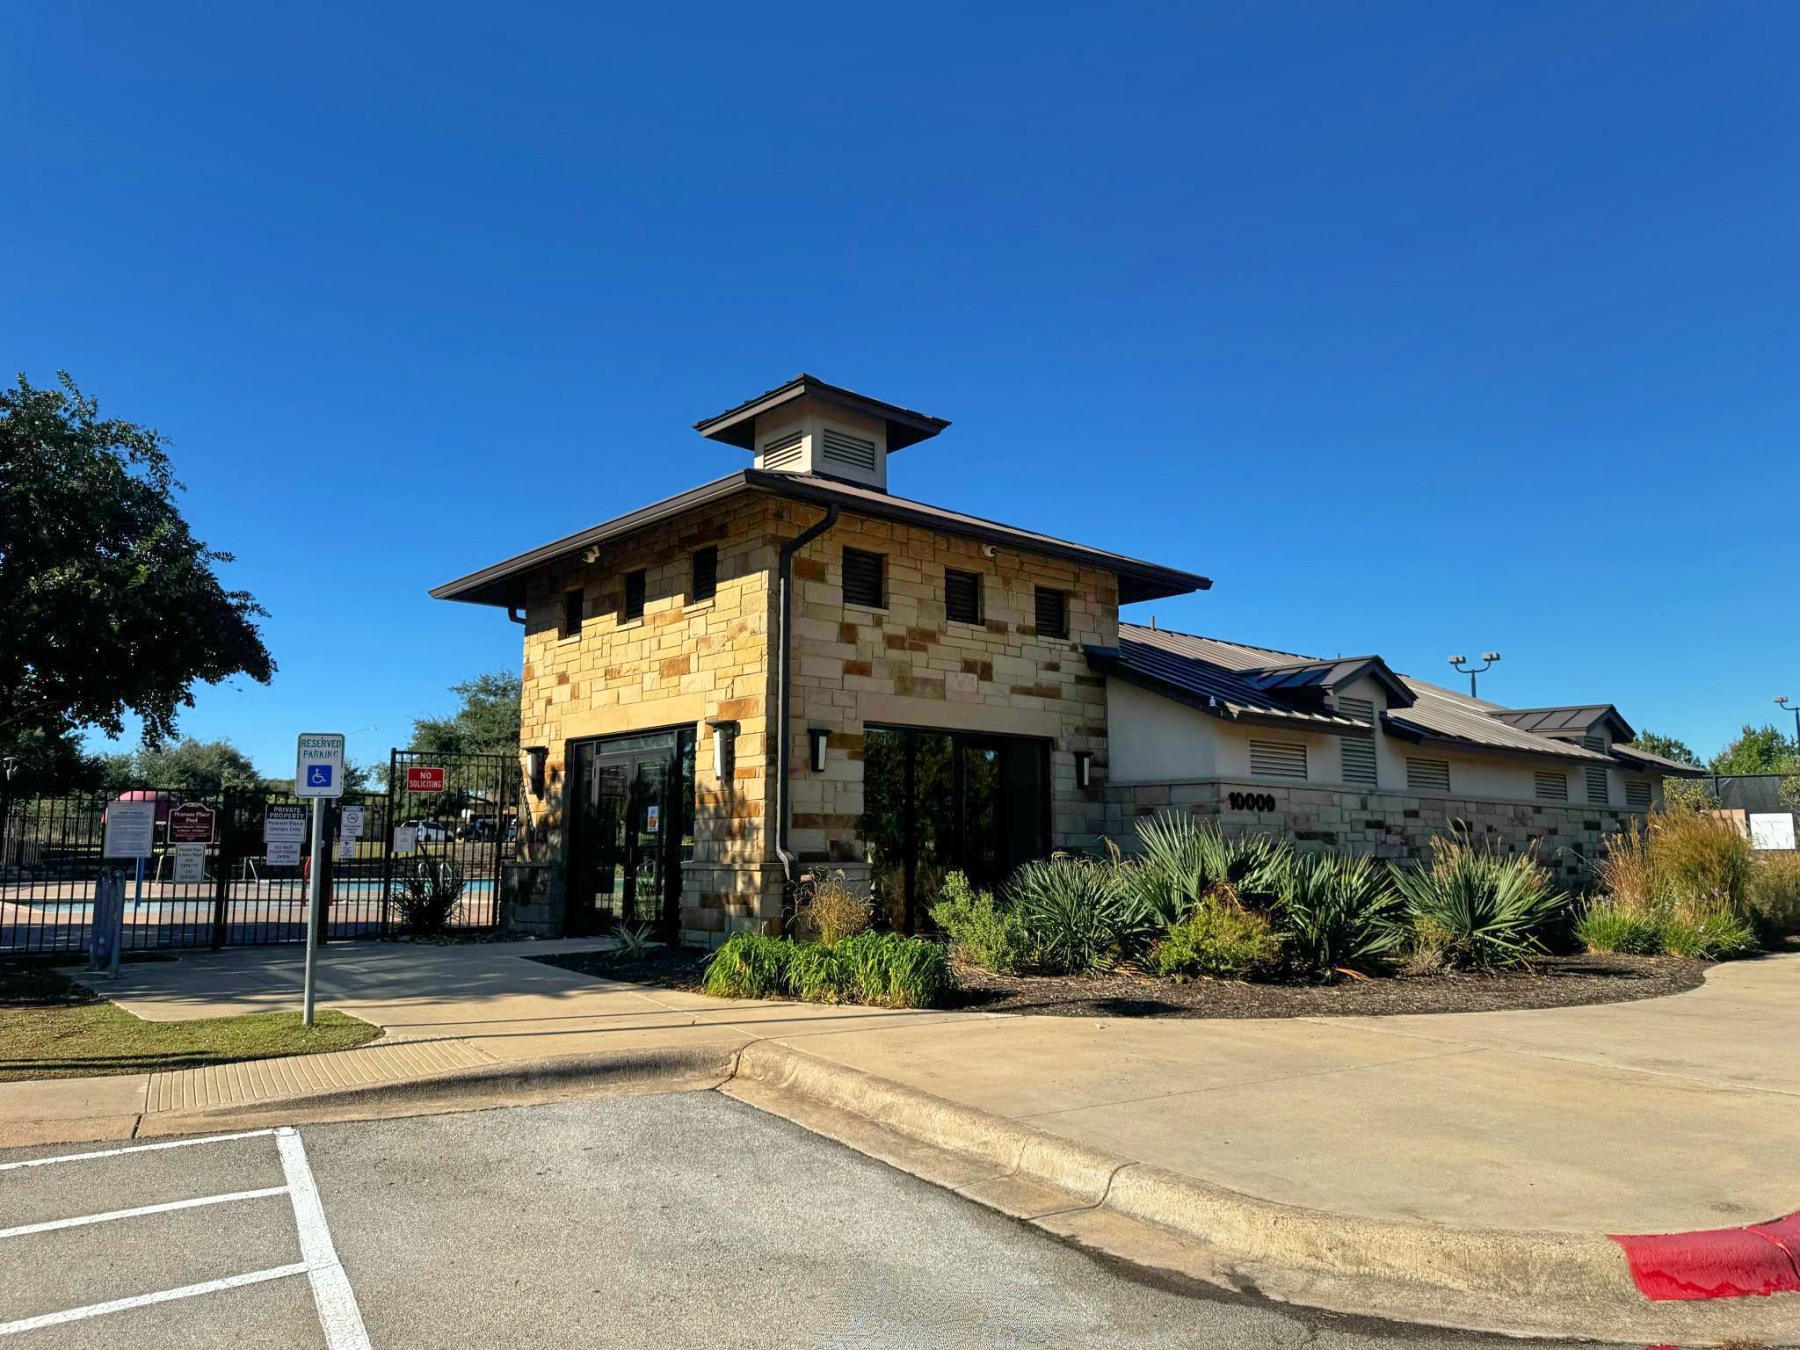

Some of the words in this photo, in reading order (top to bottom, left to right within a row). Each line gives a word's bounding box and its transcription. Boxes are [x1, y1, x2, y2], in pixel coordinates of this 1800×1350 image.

[301, 739, 342, 749] RESERVED
[303, 750, 339, 759] PARKING
[420, 771, 432, 780] NO
[409, 780, 442, 788] SOLICITING
